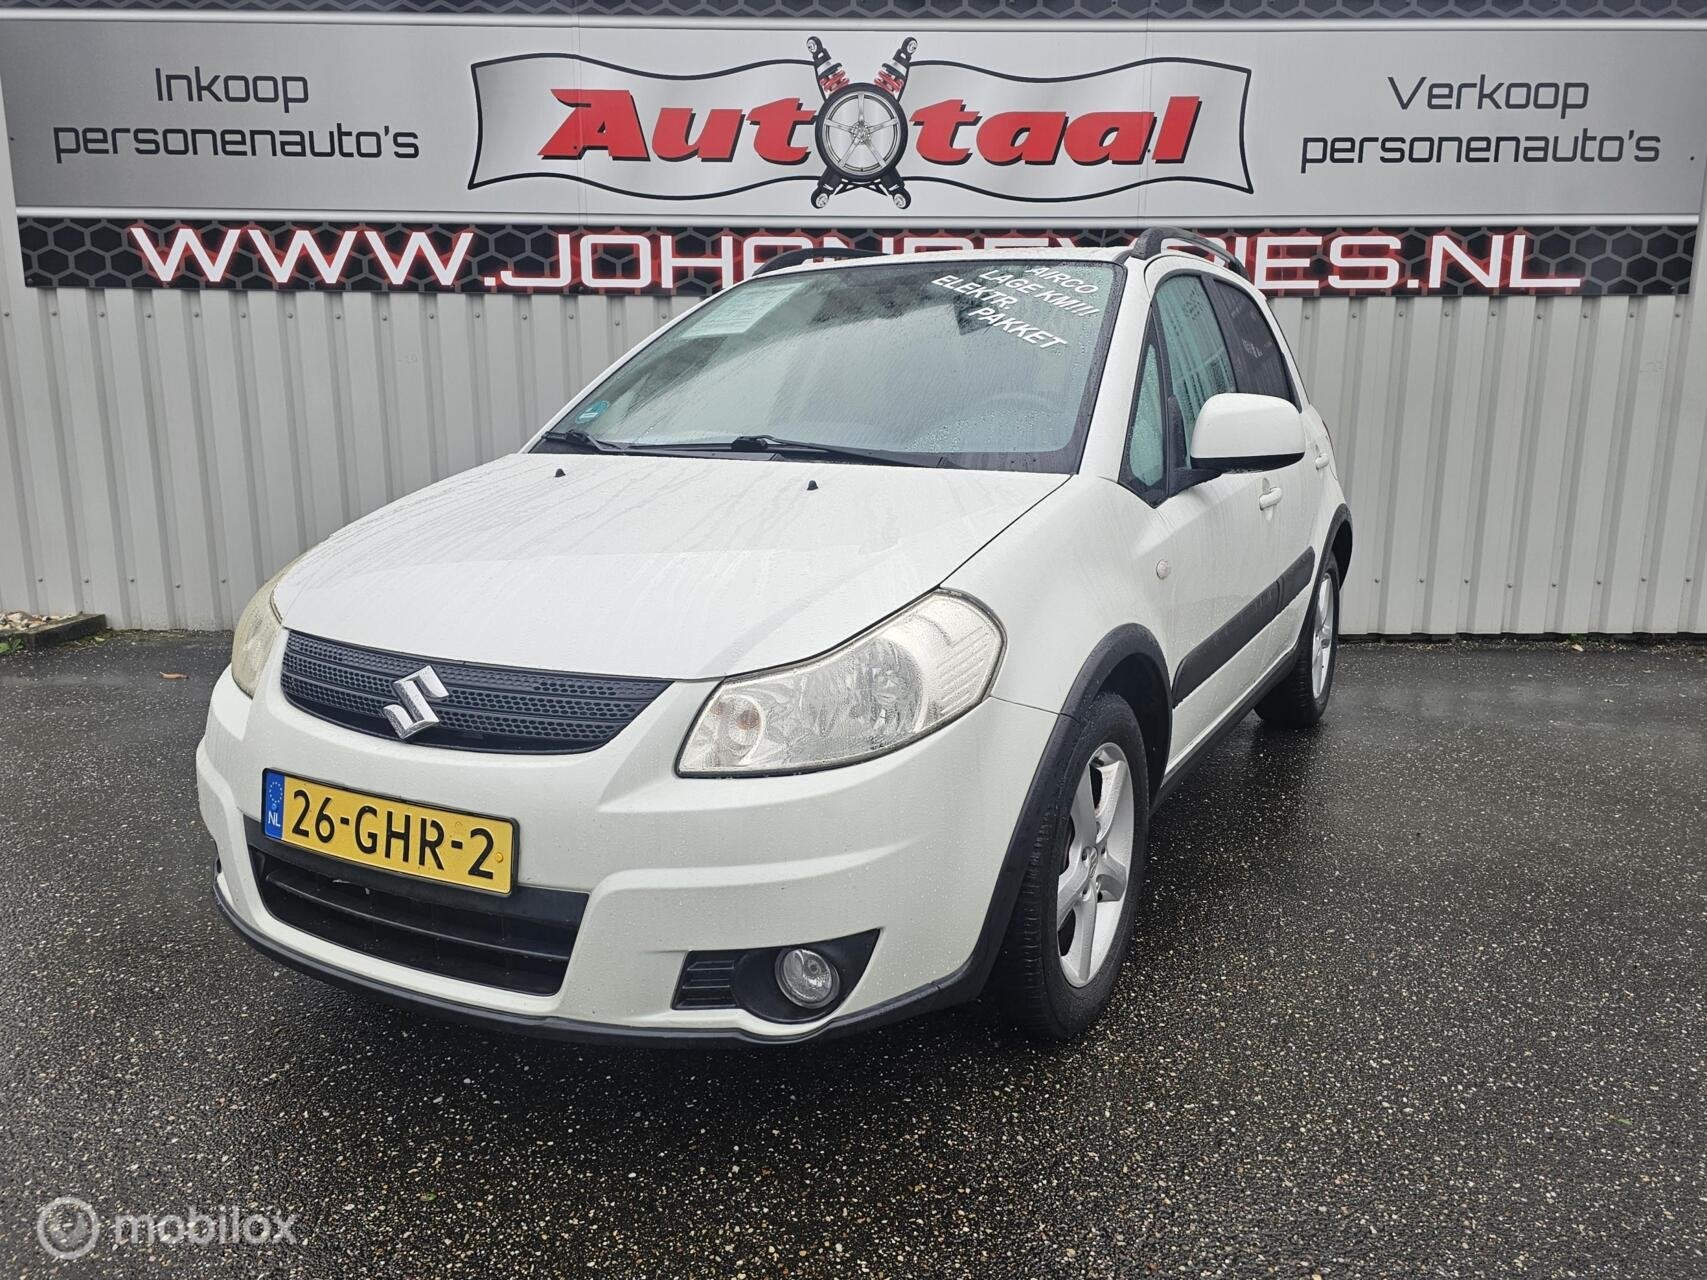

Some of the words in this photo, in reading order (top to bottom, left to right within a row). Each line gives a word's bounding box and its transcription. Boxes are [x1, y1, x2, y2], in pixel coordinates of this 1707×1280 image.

[156, 67, 309, 113] Inkoop
[1388, 74, 1590, 119] Verkoop
[53, 123, 420, 164] personenauto's
[1302, 129, 1661, 174] personenauto's
[931, 275, 1018, 310] ELEKTR.
[978, 270, 1045, 294] LAGE
[1033, 290, 1100, 316] KM!!!
[1024, 267, 1099, 294] AIRCO
[968, 307, 1067, 348] PAKKET
[267, 809, 281, 828] NL
[291, 789, 495, 880] 26-GHR-2
